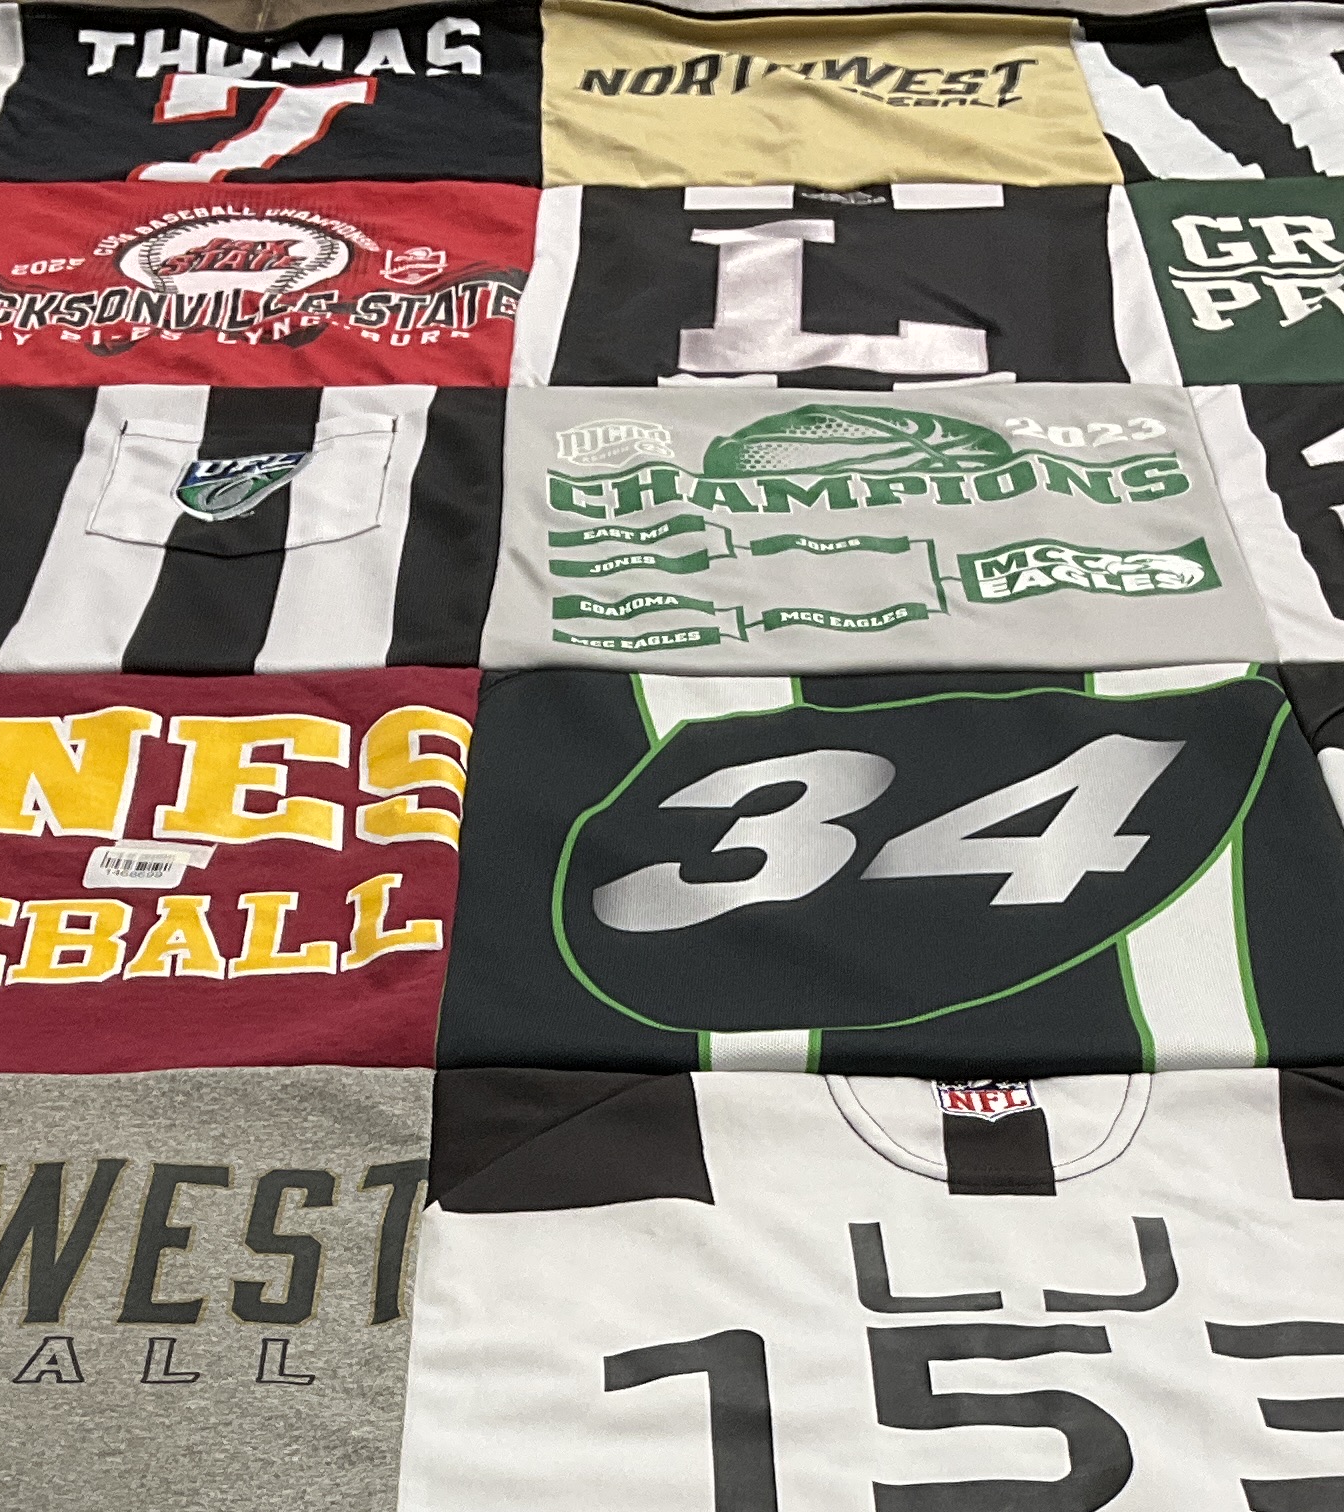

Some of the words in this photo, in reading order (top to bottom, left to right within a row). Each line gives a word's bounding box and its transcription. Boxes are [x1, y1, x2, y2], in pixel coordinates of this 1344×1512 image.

[78, 17, 482, 78] THOMAS
[126, 72, 378, 183] 7
[134, 204, 257, 235] BASEBALL
[348, 280, 523, 332] STATE
[678, 218, 989, 374] L
[1005, 416, 1167, 448] 2023
[546, 452, 1192, 520] CHAMPIONS
[583, 527, 635, 541] EAST
[640, 524, 670, 541] MS
[795, 538, 861, 551] JONES
[589, 555, 656, 574] JONES
[981, 544, 1116, 580] MCC
[978, 565, 1188, 599] EAGLES
[579, 595, 679, 617] COAHOMA
[780, 611, 825, 624] MCC
[829, 607, 909, 628] EAGLES
[620, 630, 701, 649] EAGLES
[592, 733, 1188, 932] 34
[946, 1089, 1028, 1112] NFL
[849, 1216, 1181, 1313] LJ
